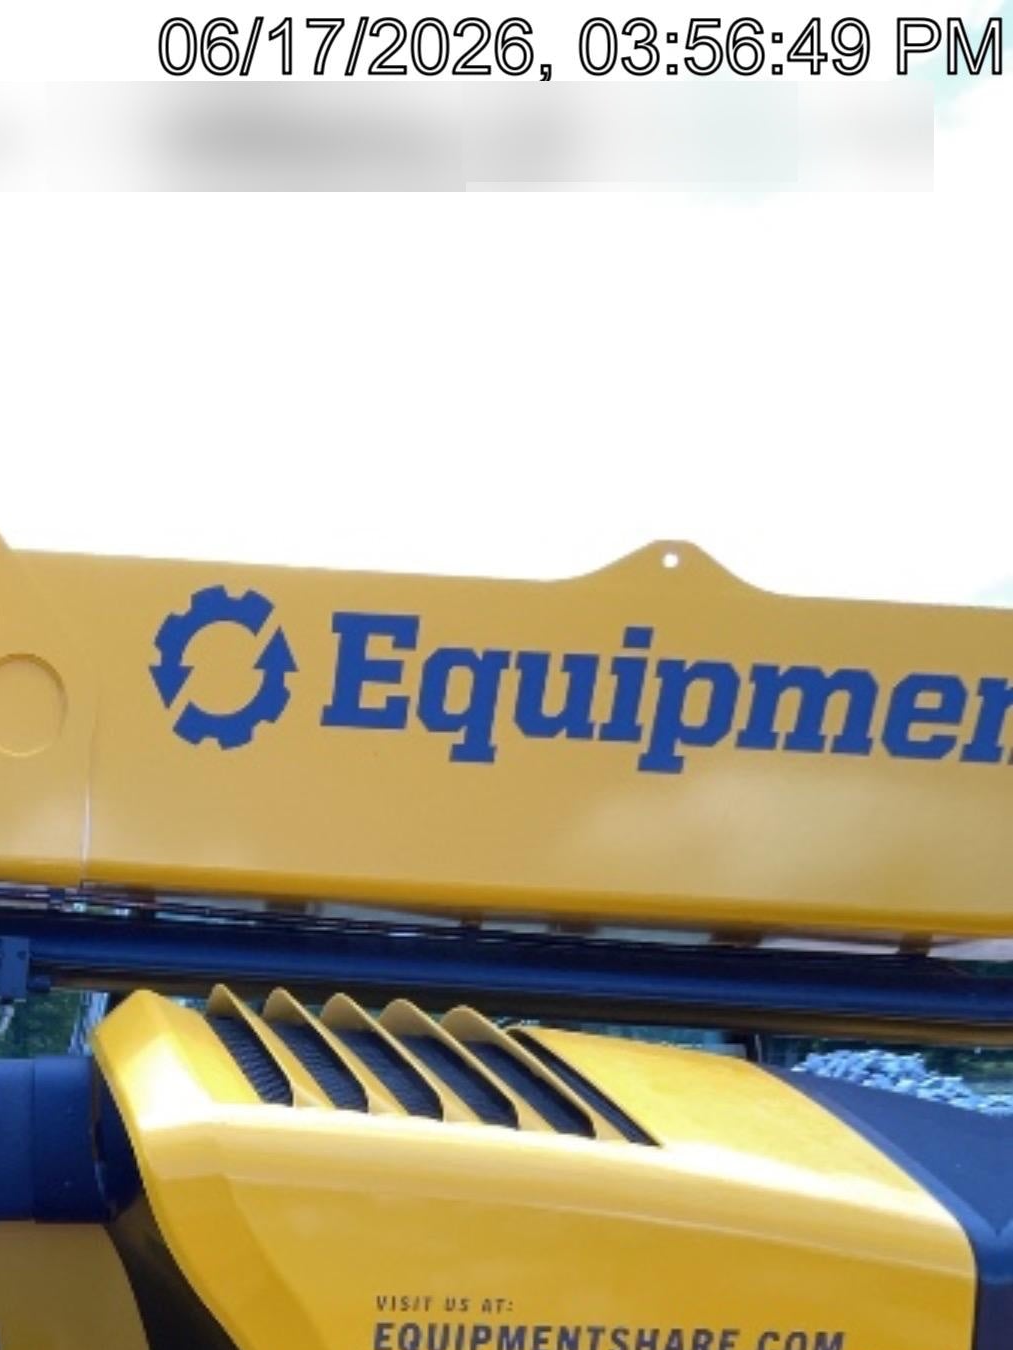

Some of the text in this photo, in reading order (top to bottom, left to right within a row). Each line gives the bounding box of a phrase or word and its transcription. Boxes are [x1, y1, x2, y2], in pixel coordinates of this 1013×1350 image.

[376, 1295, 513, 1314] VISIT US AT:
